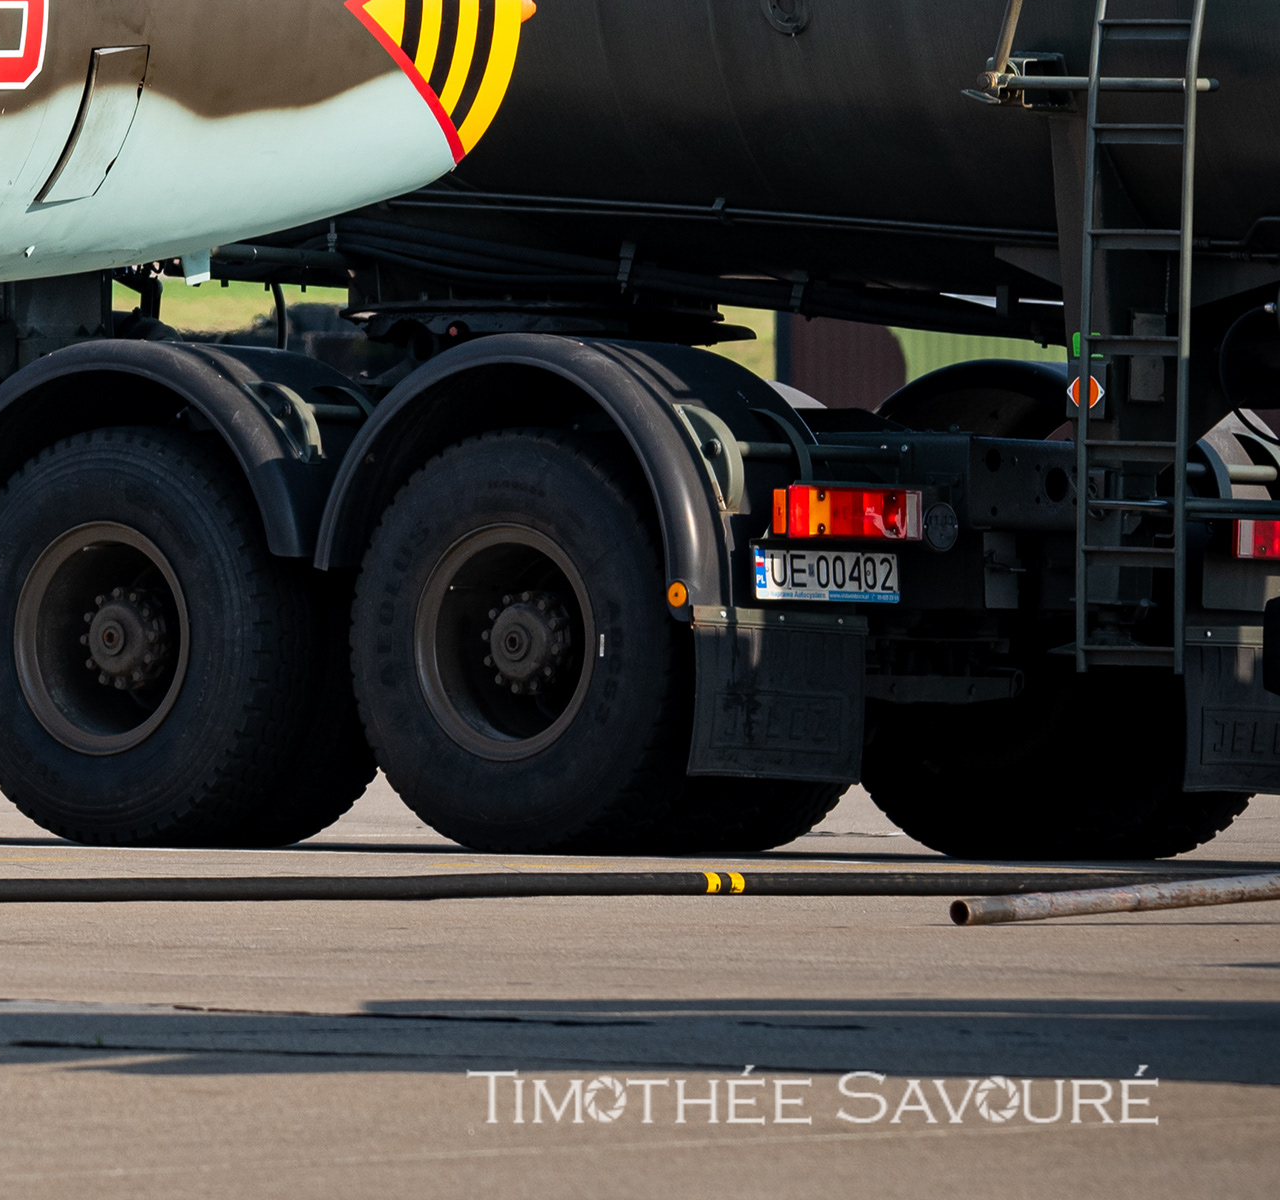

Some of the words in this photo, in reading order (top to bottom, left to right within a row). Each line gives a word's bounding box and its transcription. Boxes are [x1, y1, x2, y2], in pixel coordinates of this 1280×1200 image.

[756, 574, 766, 585] PL
[770, 553, 807, 588] UE
[816, 555, 896, 591] 00402
